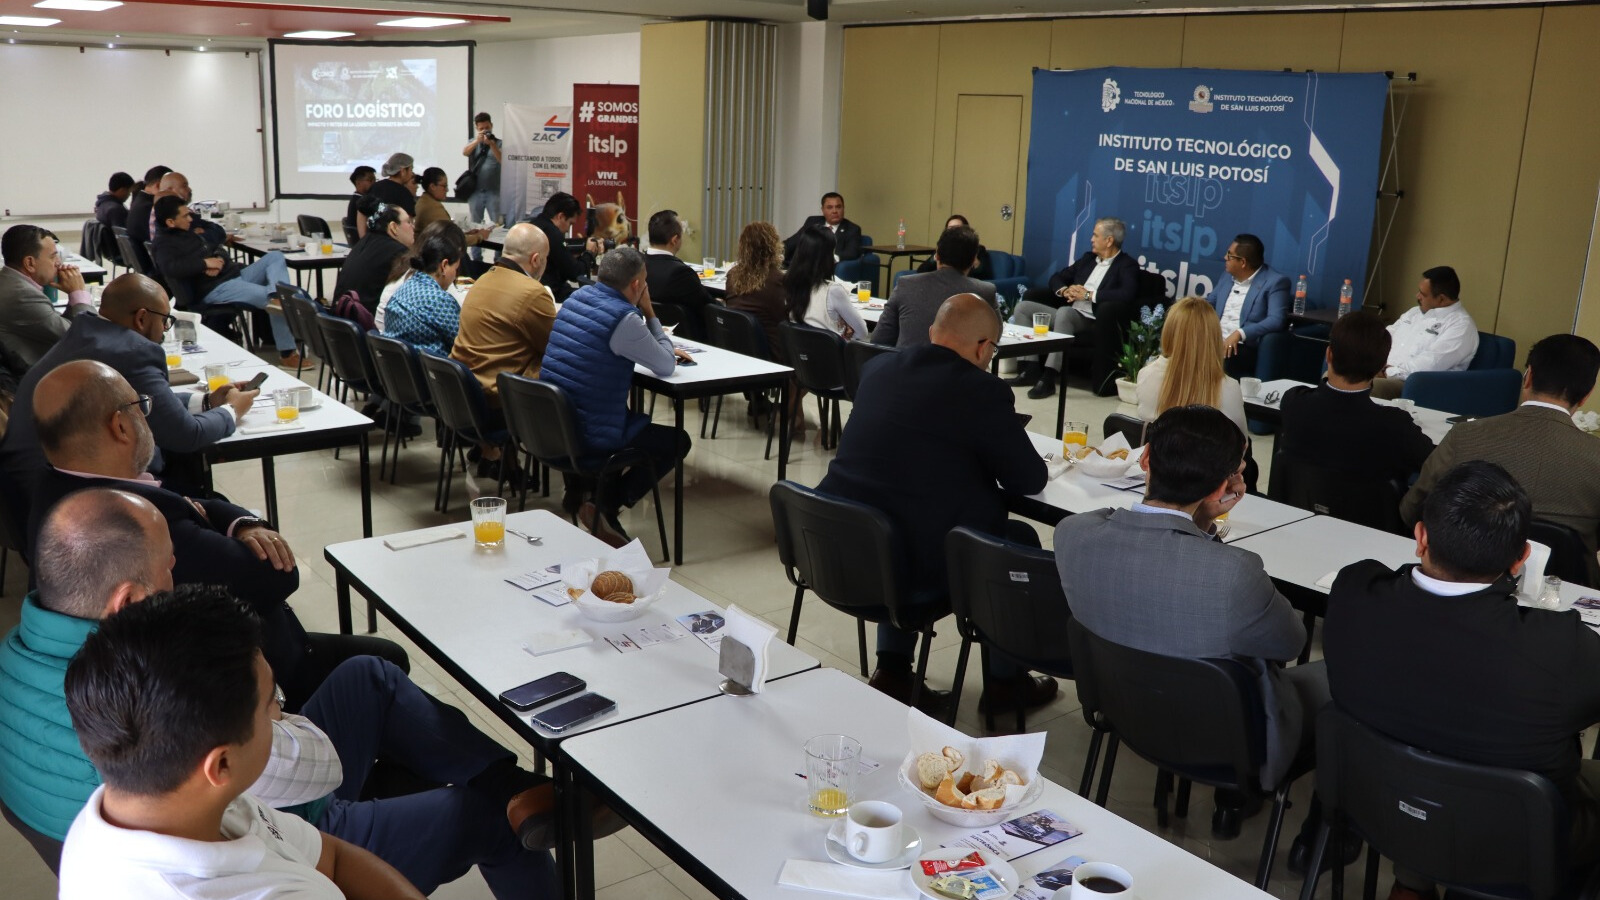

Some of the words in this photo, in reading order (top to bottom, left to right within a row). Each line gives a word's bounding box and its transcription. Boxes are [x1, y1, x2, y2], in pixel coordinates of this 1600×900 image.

[1213, 94, 1246, 102] INSTITUTO
[1247, 94, 1294, 103] TECNOLÓGICO
[305, 103, 344, 118] FORO
[347, 100, 425, 118] LOGÍSTICO
[597, 101, 638, 113] SOMOS
[1245, 104, 1259, 112] LUIS
[1260, 104, 1285, 112] POTOSÍ
[597, 114, 638, 124] GRANDES
[532, 133, 556, 142] ZAC
[588, 134, 628, 158] itslp
[1099, 133, 1172, 151] INSTITUTO
[1176, 137, 1292, 160] TECNOLÓGICO
[597, 171, 618, 179] VIVE
[1114, 157, 1133, 172] DE
[1137, 159, 1167, 175] SAN
[1171, 161, 1205, 178] LUIS
[1209, 165, 1269, 183] POTOSÍ
[1144, 172, 1223, 218] itslp
[1141, 209, 1218, 264] itslp
